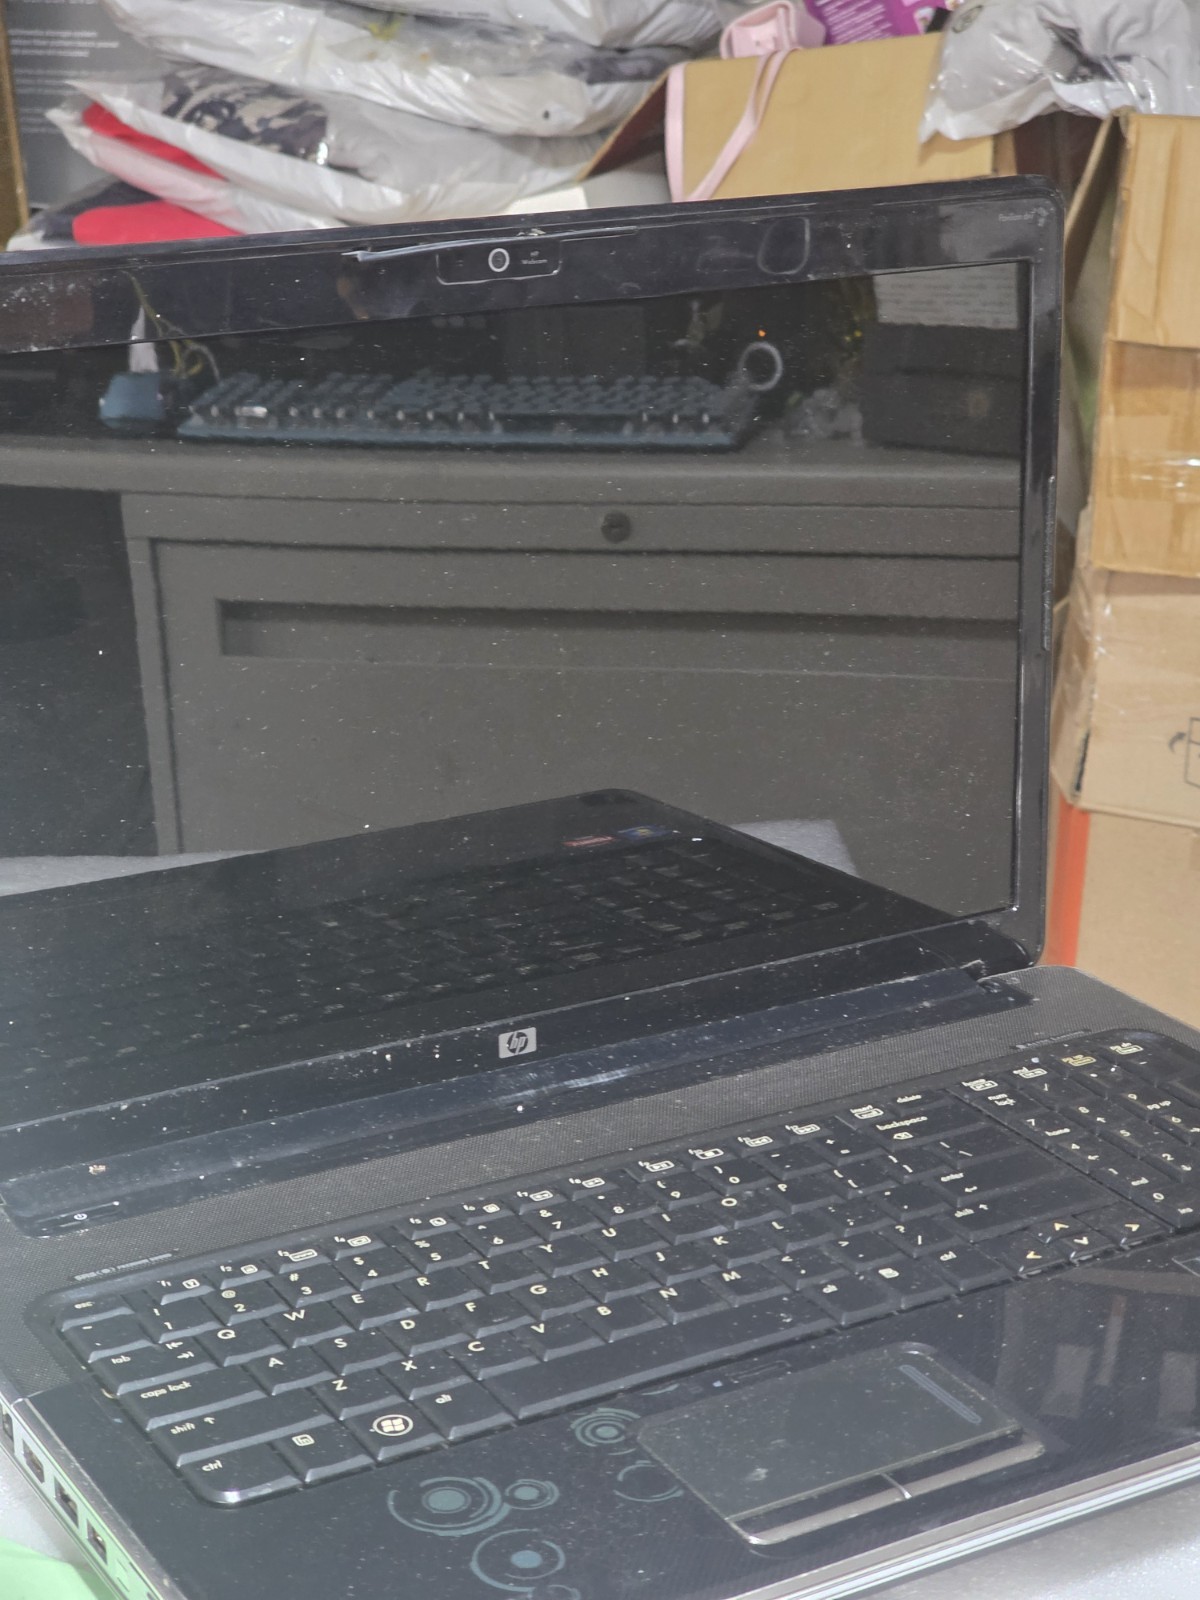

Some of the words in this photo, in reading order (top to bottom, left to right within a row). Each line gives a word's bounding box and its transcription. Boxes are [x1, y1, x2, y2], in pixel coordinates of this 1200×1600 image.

[1161, 1153, 1175, 1161] 2
[777, 1183, 788, 1192] P
[670, 1191, 681, 1199] 9
[1152, 1192, 1165, 1200] 0
[613, 1206, 624, 1214] 8
[552, 1221, 562, 1229] 7
[771, 1221, 784, 1229] L
[602, 1227, 617, 1238] U
[493, 1237, 504, 1245] 6
[713, 1235, 729, 1246] K
[539, 1244, 553, 1253] Y
[656, 1251, 666, 1262] J
[478, 1260, 490, 1269] T
[368, 1269, 378, 1277] 4
[591, 1267, 609, 1278] H
[722, 1271, 742, 1282] M
[416, 1277, 430, 1287] R
[300, 1286, 312, 1295] 3
[530, 1285, 547, 1295] G
[659, 1287, 678, 1298] N
[351, 1294, 365, 1304] E
[234, 1304, 246, 1312] 2
[465, 1302, 477, 1312] F
[596, 1306, 612, 1316] B
[283, 1310, 305, 1321] W
[400, 1319, 416, 1330] D
[530, 1323, 545, 1334] V
[217, 1329, 236, 1339] Q
[334, 1338, 348, 1348] S
[467, 1341, 485, 1352] C
[111, 1355, 131, 1364] tab
[268, 1357, 284, 1368] A
[401, 1360, 418, 1371] X
[140, 1389, 167, 1398] caps
[167, 1381, 192, 1392] lock
[331, 1379, 348, 1391] Z
[170, 1422, 196, 1435] shift
[202, 1460, 223, 1471] ctrl
